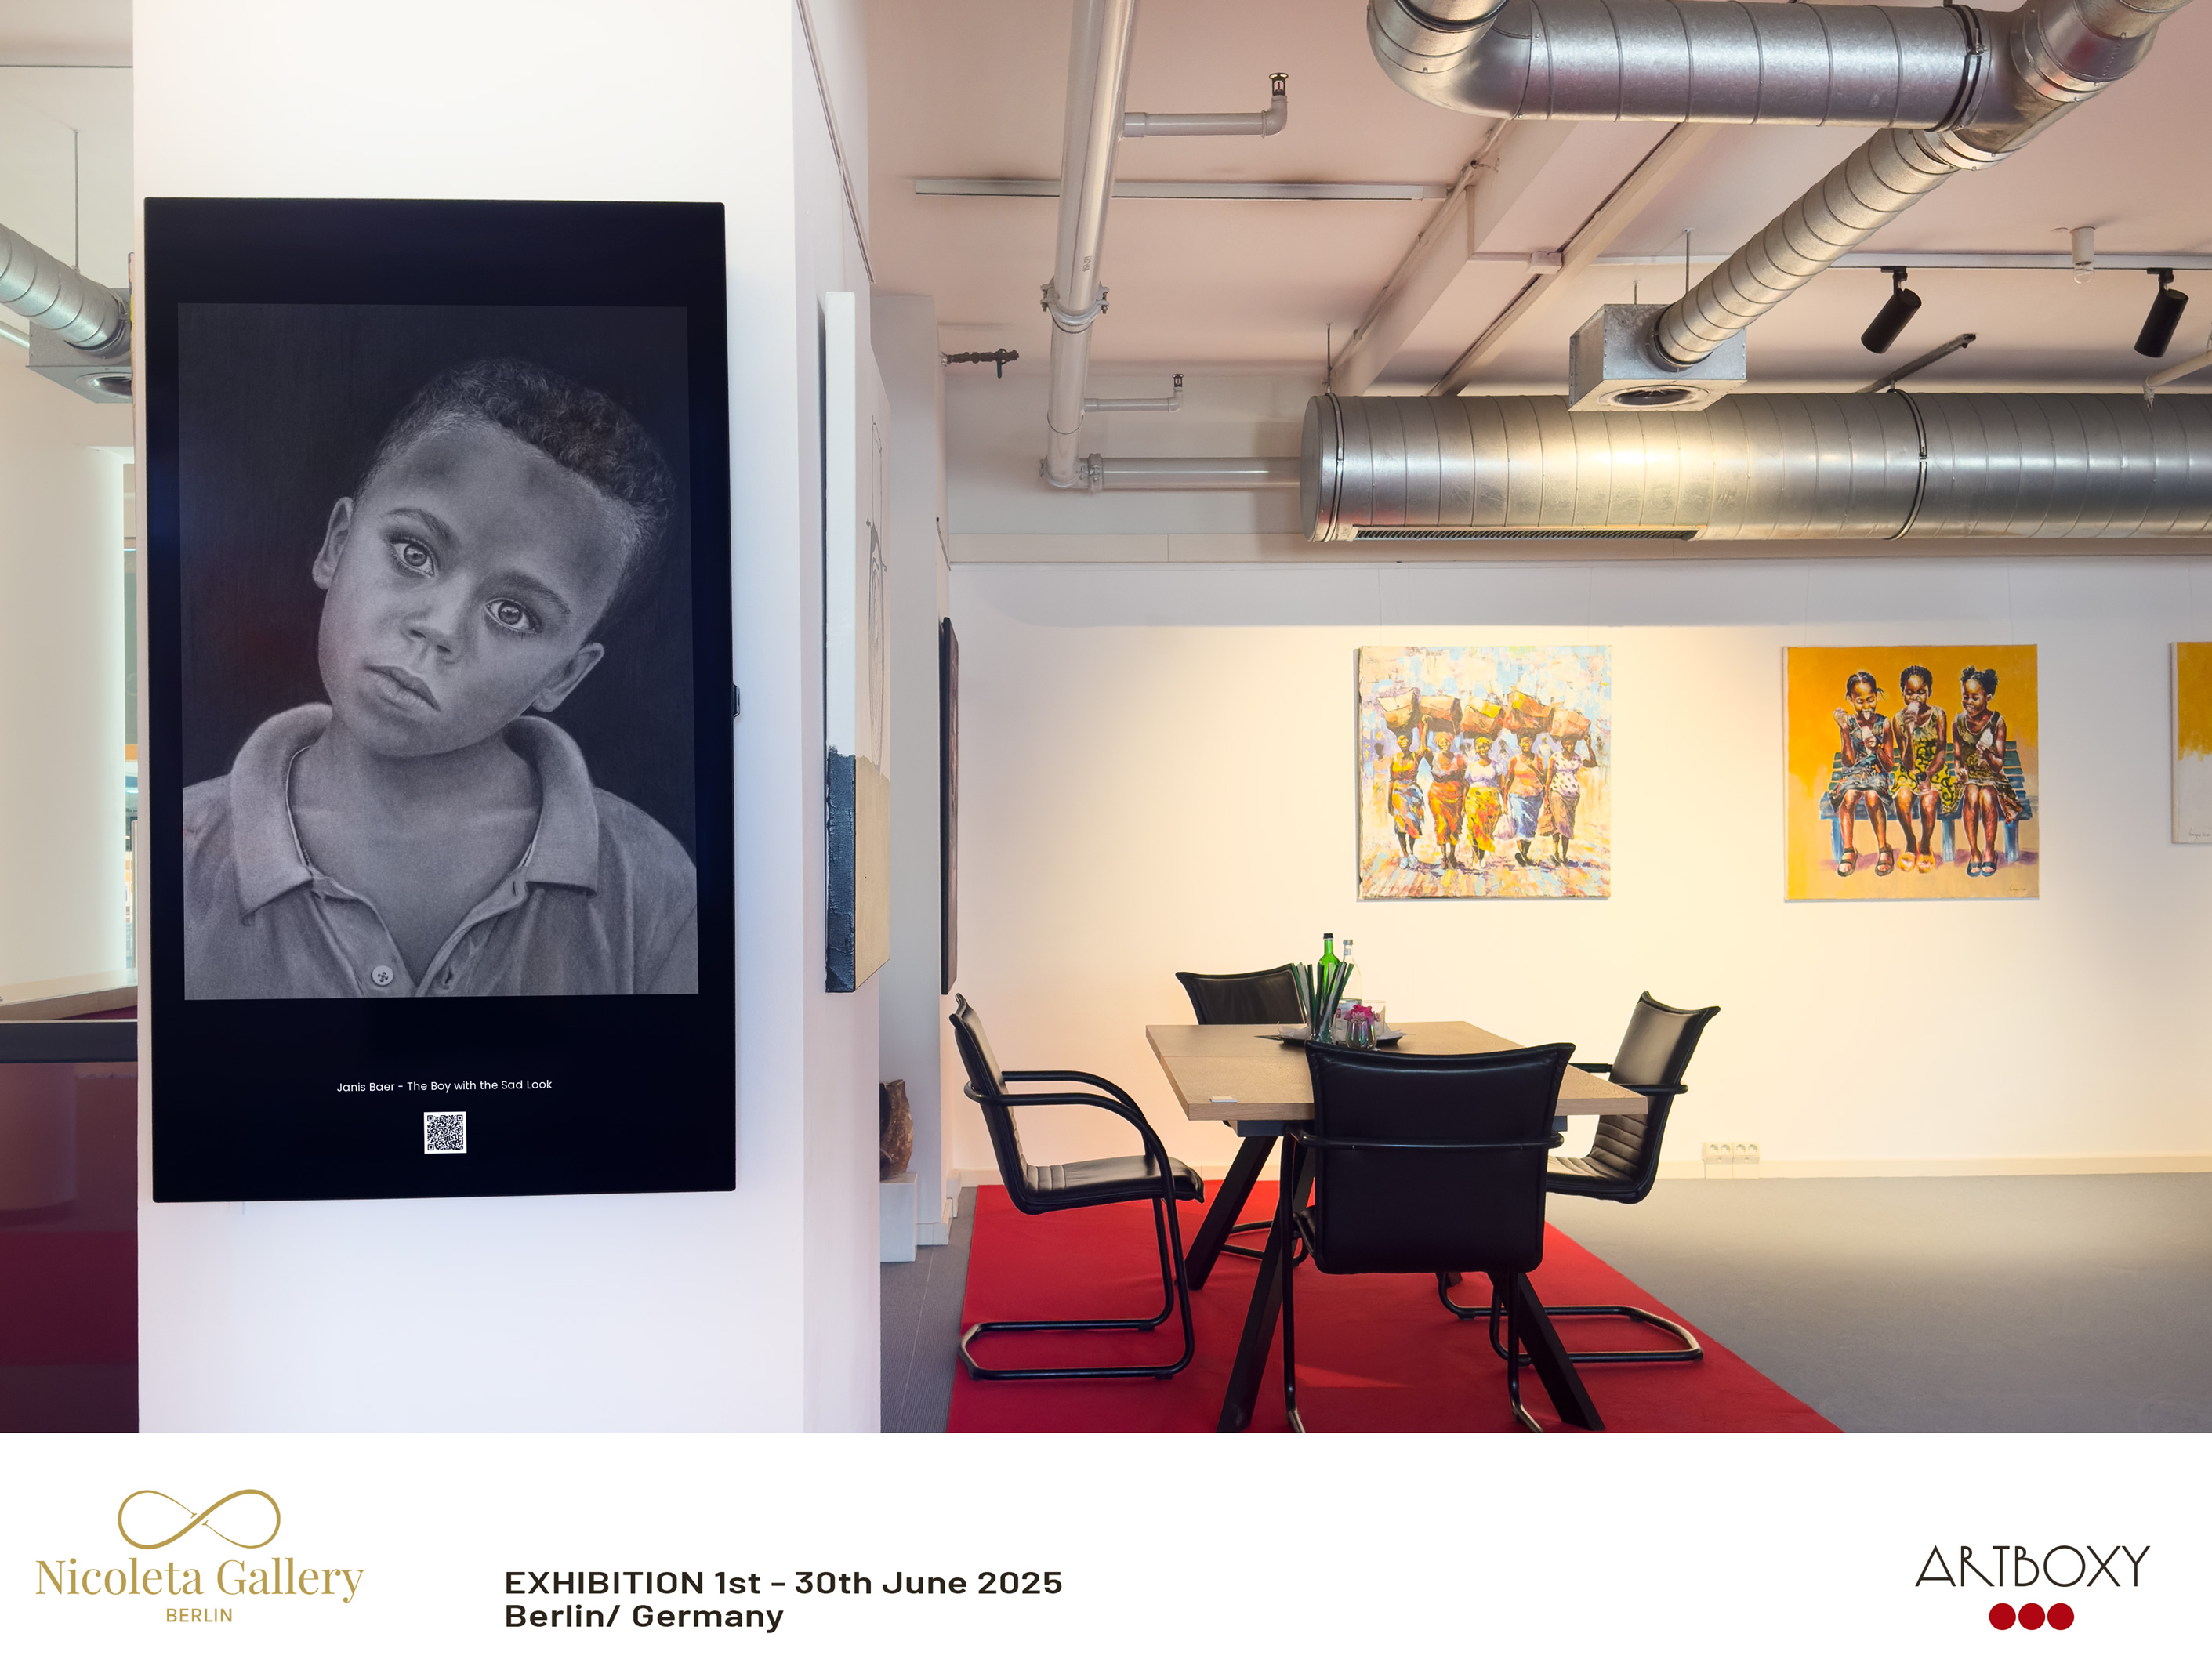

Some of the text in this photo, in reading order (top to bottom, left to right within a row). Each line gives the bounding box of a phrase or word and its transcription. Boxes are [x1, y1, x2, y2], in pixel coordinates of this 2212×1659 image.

[336, 1082, 366, 1092] Janis
[369, 1082, 395, 1092] Baer
[407, 1081, 428, 1091] The
[430, 1081, 451, 1093] Boy
[453, 1080, 477, 1091] with
[480, 1080, 499, 1090] the
[501, 1079, 523, 1090] Sad
[527, 1079, 553, 1089] Look
